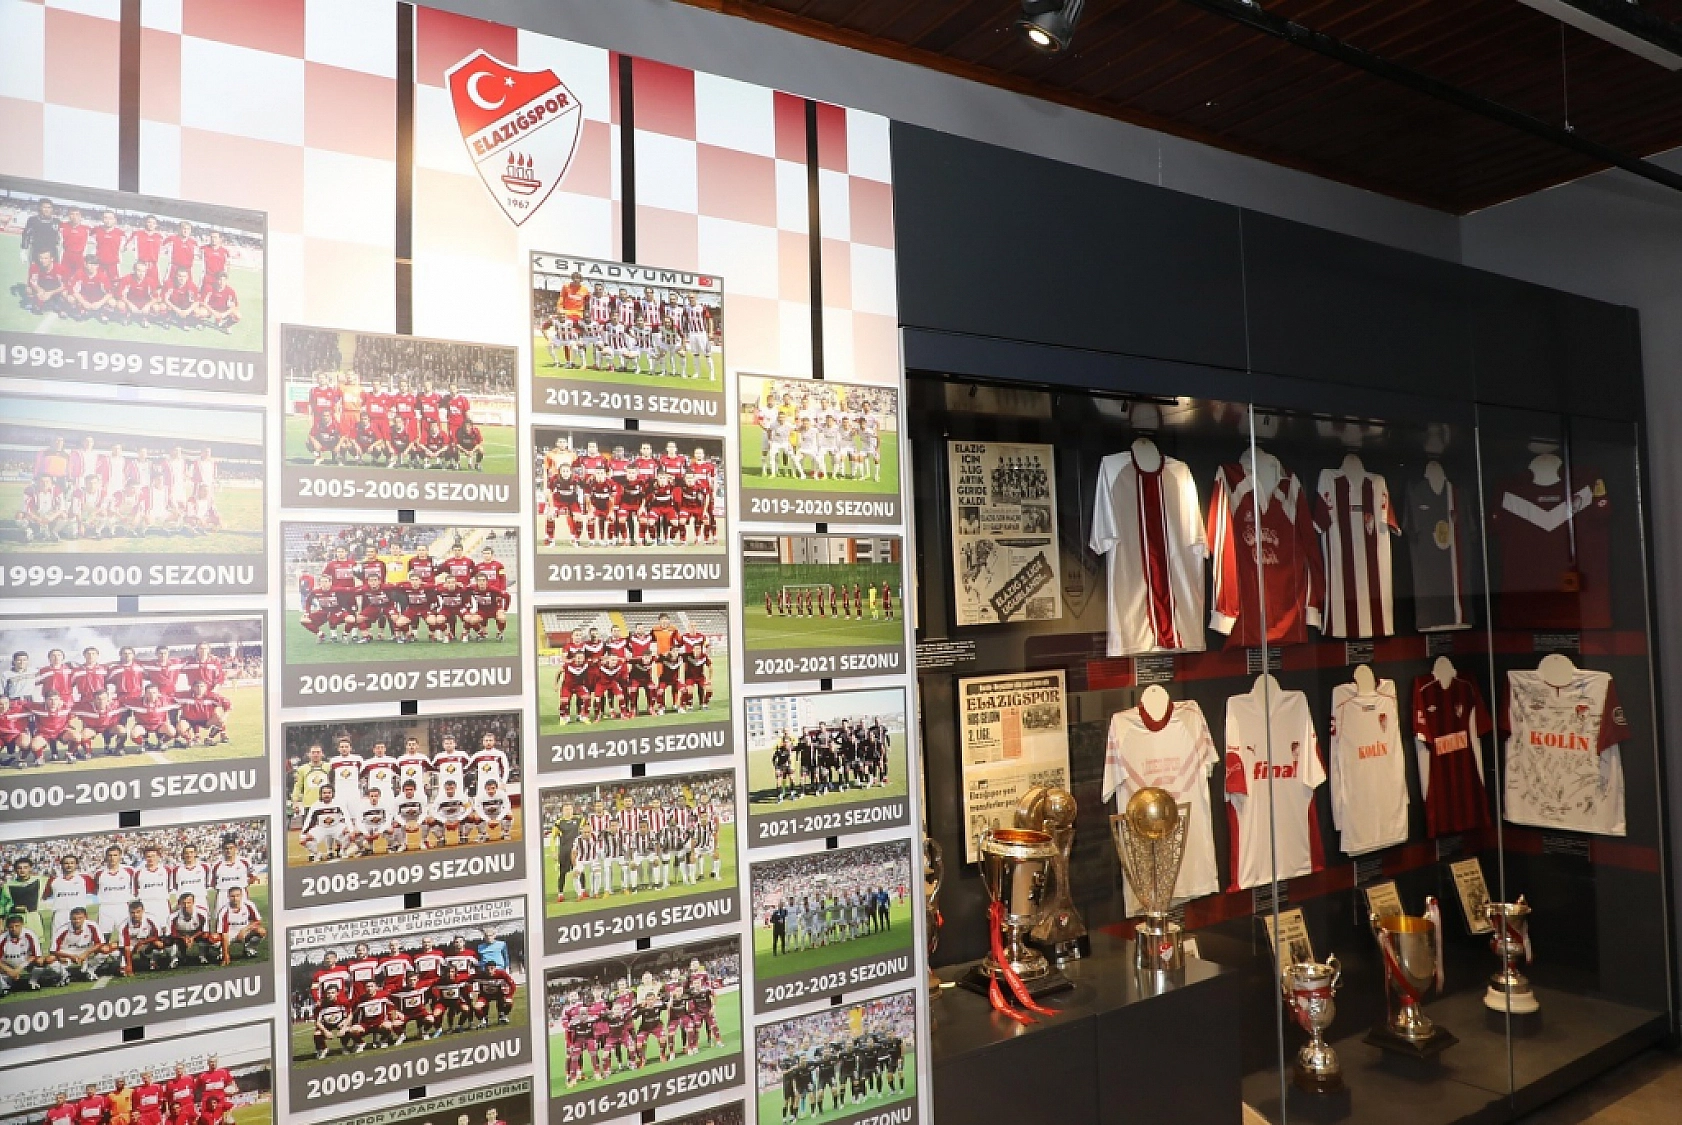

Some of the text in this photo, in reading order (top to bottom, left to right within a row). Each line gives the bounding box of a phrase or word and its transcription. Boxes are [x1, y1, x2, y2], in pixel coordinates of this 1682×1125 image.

[472, 92, 571, 156] ELAZIĞSPOR
[507, 197, 530, 209] 1967
[555, 258, 694, 285] STADYUMU
[149, 355, 254, 381] SEZONU
[545, 388, 717, 416] 2012-2013 SEZONU
[298, 478, 510, 502] 2005-2006 SEZONU
[751, 497, 894, 517] 2019-2020 SEZONU
[149, 565, 254, 585] SEZONU
[548, 563, 721, 582] 2013-2014 SEZONU
[754, 655, 836, 675] 2020-2021
[840, 652, 899, 671] SEZONU
[298, 666, 512, 695] 2006-2007 SEZONU
[551, 730, 725, 762] 2014-2015 SEZONU
[1253, 760, 1299, 780] final
[0, 768, 256, 811] 2000-2001 SEZONU
[759, 803, 904, 839] 2021-2022 SEZONU
[301, 852, 515, 898] 2008-2009 SEZONU
[332, 925, 400, 940] YAPARAK
[557, 897, 732, 944] 2015-2016 SEZONU
[764, 955, 908, 1004] 2022-2023 SEZONU
[0, 975, 261, 1038] 2001-2002 SEZONU
[306, 1037, 521, 1100] 2009-2010 SEZONU
[562, 1062, 736, 1123] 2016-2017 SEZONU
[389, 1098, 454, 1119] YAPARAK
[854, 1106, 912, 1125] ZONU
